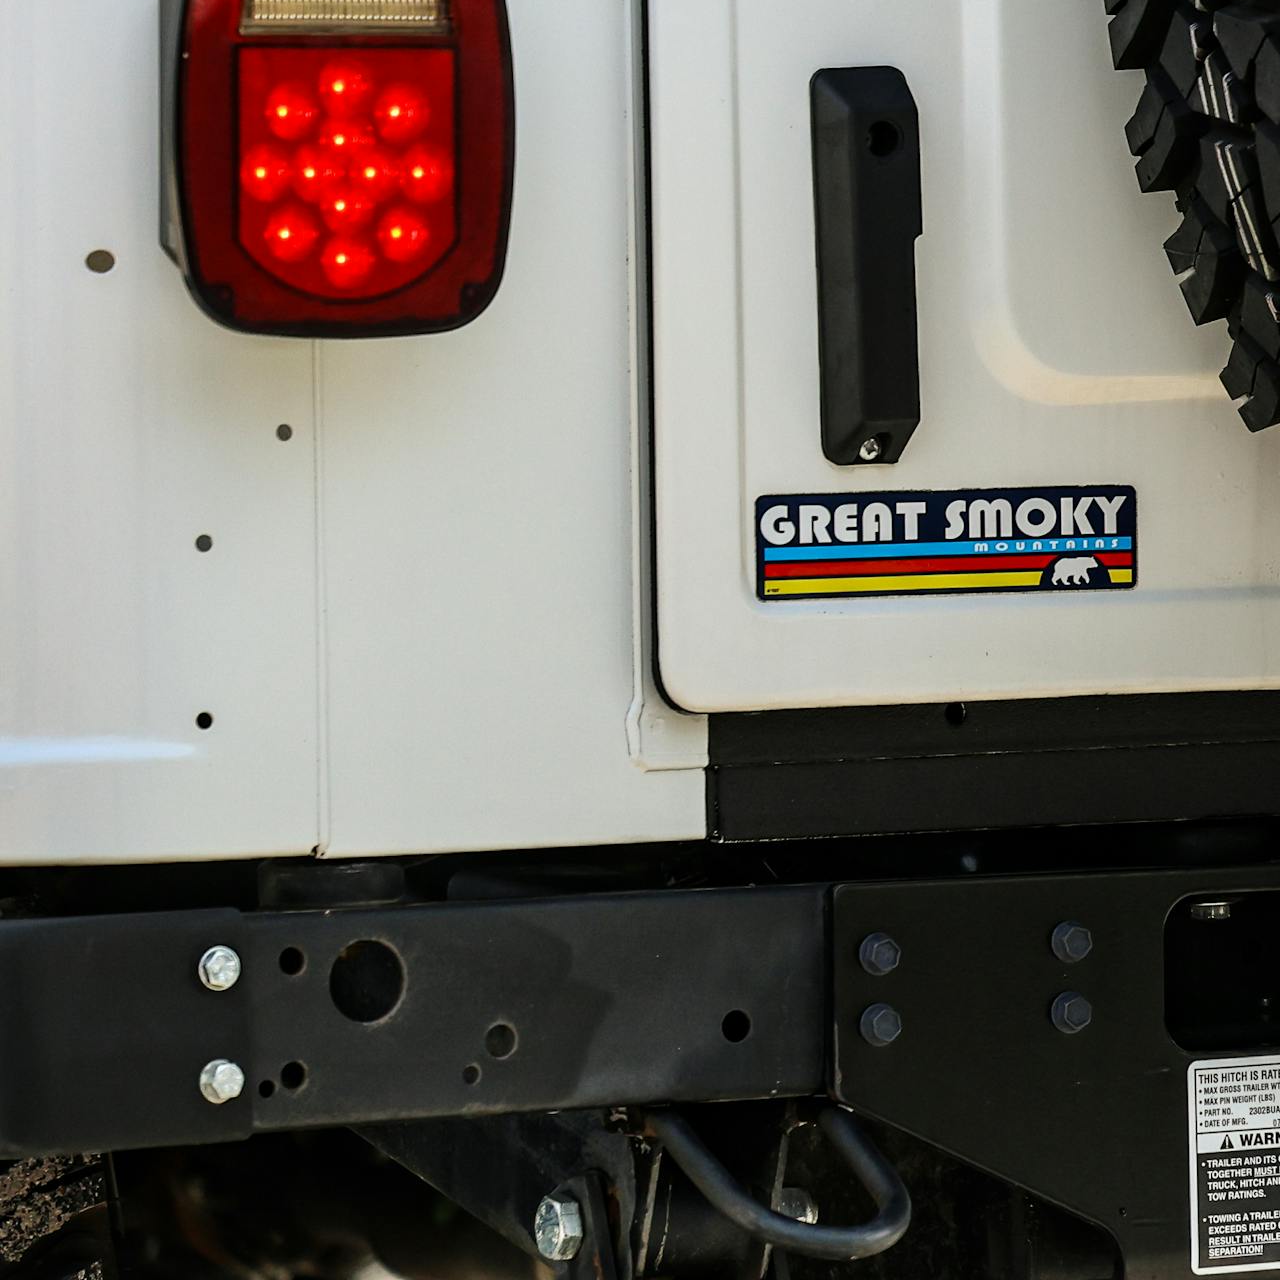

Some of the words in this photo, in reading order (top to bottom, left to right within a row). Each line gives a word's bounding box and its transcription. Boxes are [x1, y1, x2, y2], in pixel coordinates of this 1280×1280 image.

[760, 502, 926, 545] GREAT
[945, 496, 1126, 540] SMOKY
[974, 538, 1119, 552] MOUNTAINS
[1199, 1074, 1218, 1084] THIS
[1221, 1072, 1247, 1082] HITCH
[1250, 1071, 1258, 1080] IS
[1220, 1085, 1241, 1093] GROSS
[1244, 1083, 1269, 1092] TRAILER
[1271, 1082, 1280, 1090] WT.
[1204, 1098, 1218, 1106] MAX
[1232, 1095, 1256, 1103] WEIGHT
[1258, 1094, 1275, 1103] (LBS)
[1205, 1120, 1220, 1128] DATE
[1207, 1158, 1242, 1168] TRAILER
[1244, 1156, 1262, 1166] AND
[1263, 1155, 1277, 1164] ITS
[1207, 1168, 1252, 1179] TOGETHER
[1254, 1167, 1277, 1176] MUST
[1207, 1180, 1239, 1190] TRUCK,
[1240, 1178, 1264, 1188] HITCH
[1208, 1192, 1226, 1201] TOW
[1228, 1189, 1266, 1200] RATINGS.
[1208, 1213, 1241, 1224] TOWING
[1242, 1212, 1250, 1221] A
[1208, 1225, 1247, 1235] EXCEEDS
[1249, 1223, 1276, 1232] RATED
[1208, 1235, 1240, 1246] RESULT
[1242, 1234, 1251, 1243] IN
[1208, 1245, 1263, 1258] SEPARATION!
